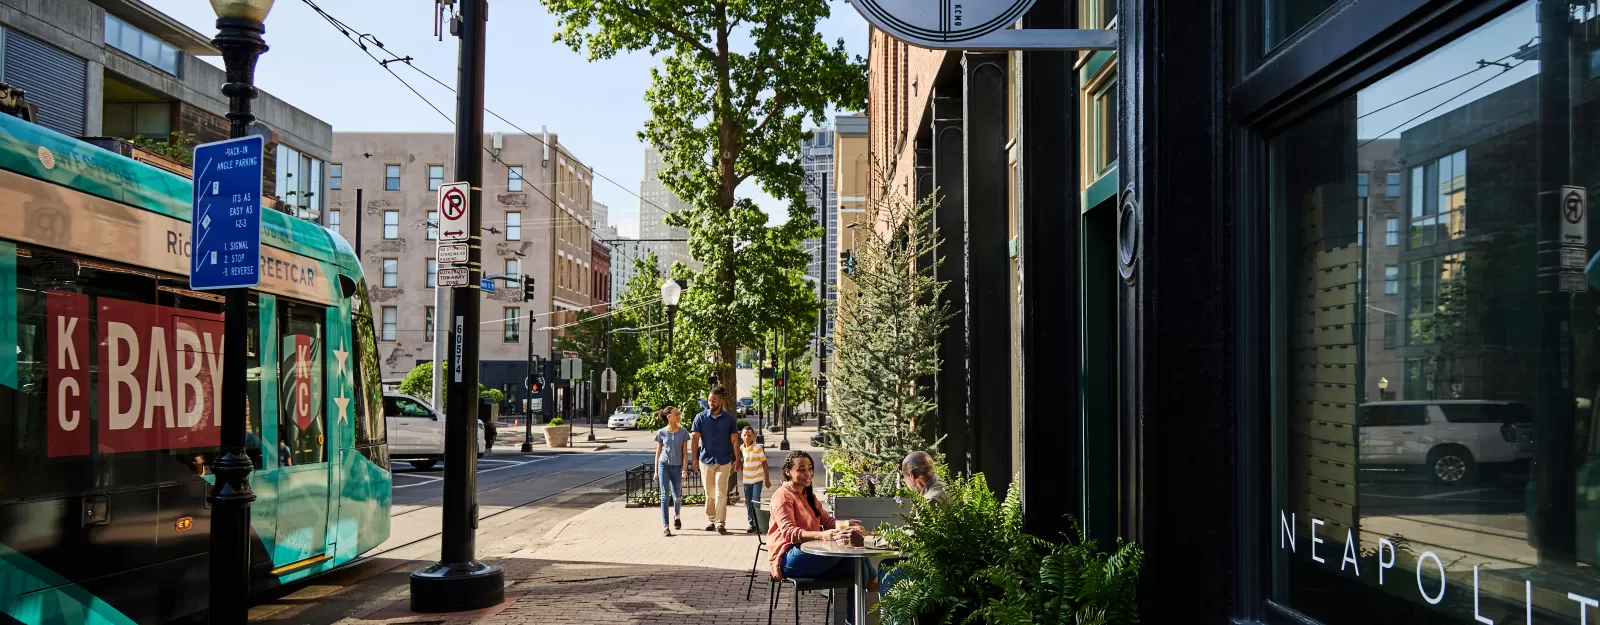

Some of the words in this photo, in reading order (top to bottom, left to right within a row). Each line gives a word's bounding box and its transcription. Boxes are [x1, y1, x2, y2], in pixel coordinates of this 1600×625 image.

[226, 145, 248, 156] BACK-IN
[216, 161, 233, 171] ANGLE
[235, 157, 258, 168] PARKING
[243, 192, 251, 202] AS
[229, 207, 244, 216] EASY
[245, 205, 253, 215] AS
[235, 219, 247, 228] 1-2-3
[166, 230, 191, 257] Rid
[230, 241, 249, 250] SIGNAL
[231, 254, 245, 263] STOP
[231, 265, 254, 275] REVERSE
[260, 255, 315, 286] REETCAR
